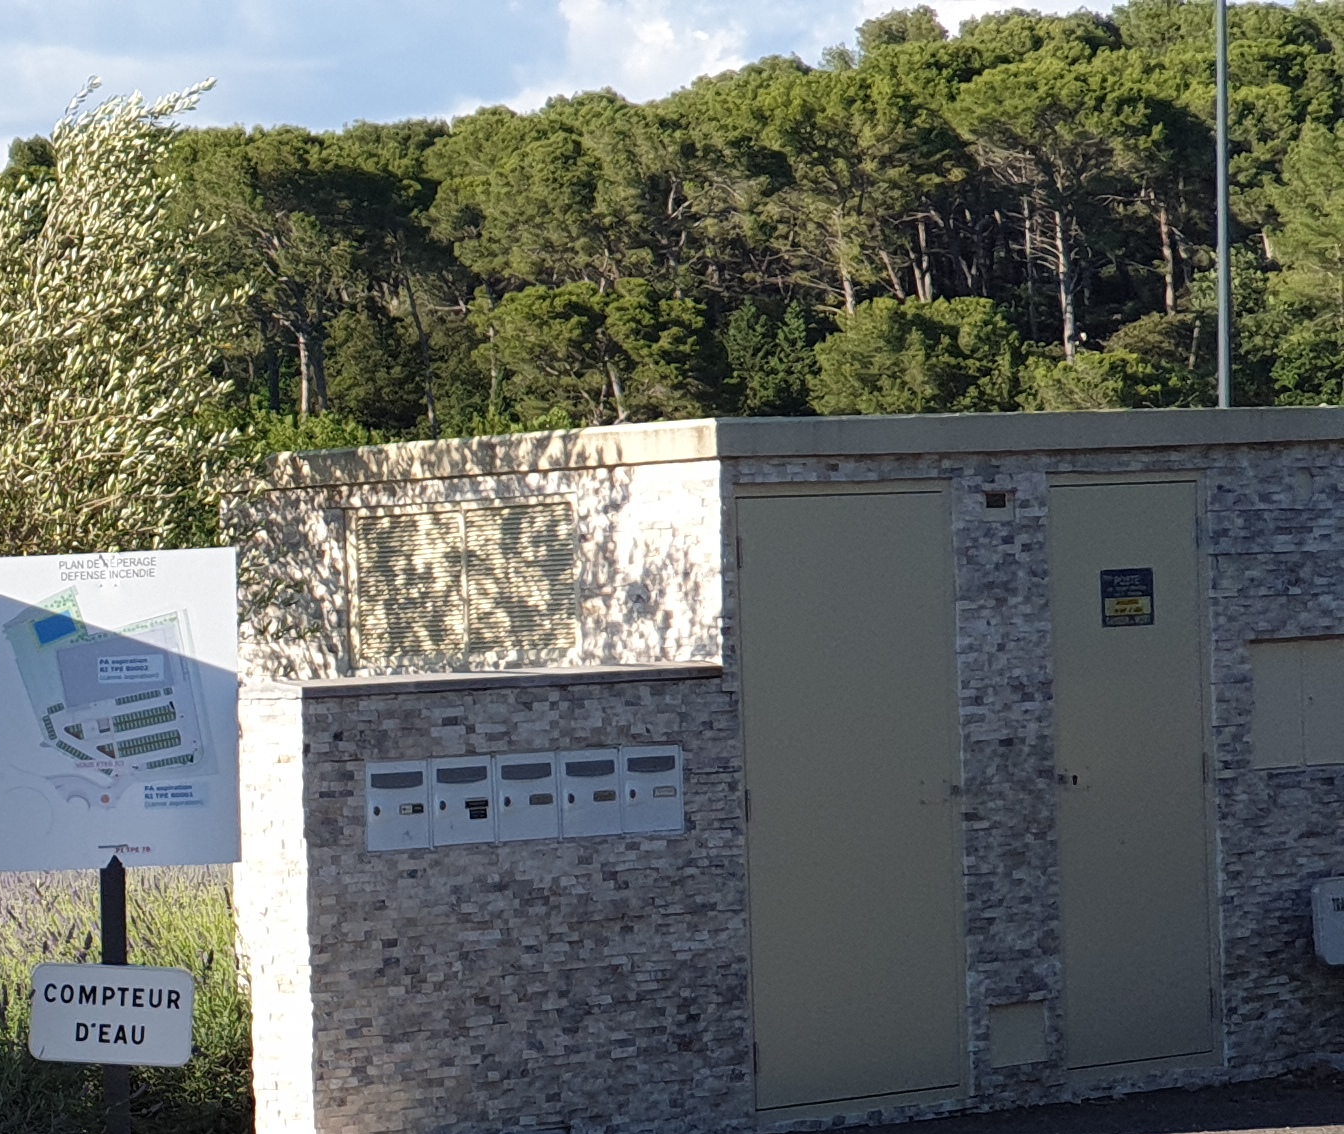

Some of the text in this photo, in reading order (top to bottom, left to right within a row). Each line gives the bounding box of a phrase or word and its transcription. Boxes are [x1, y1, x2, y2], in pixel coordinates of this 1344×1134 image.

[59, 560, 84, 570] PLAN
[87, 559, 100, 569] DE
[61, 568, 156, 581] DEFENSE INCENDIE
[43, 983, 181, 1010] COMPTEUR
[75, 1022, 146, 1045] D'EAU
